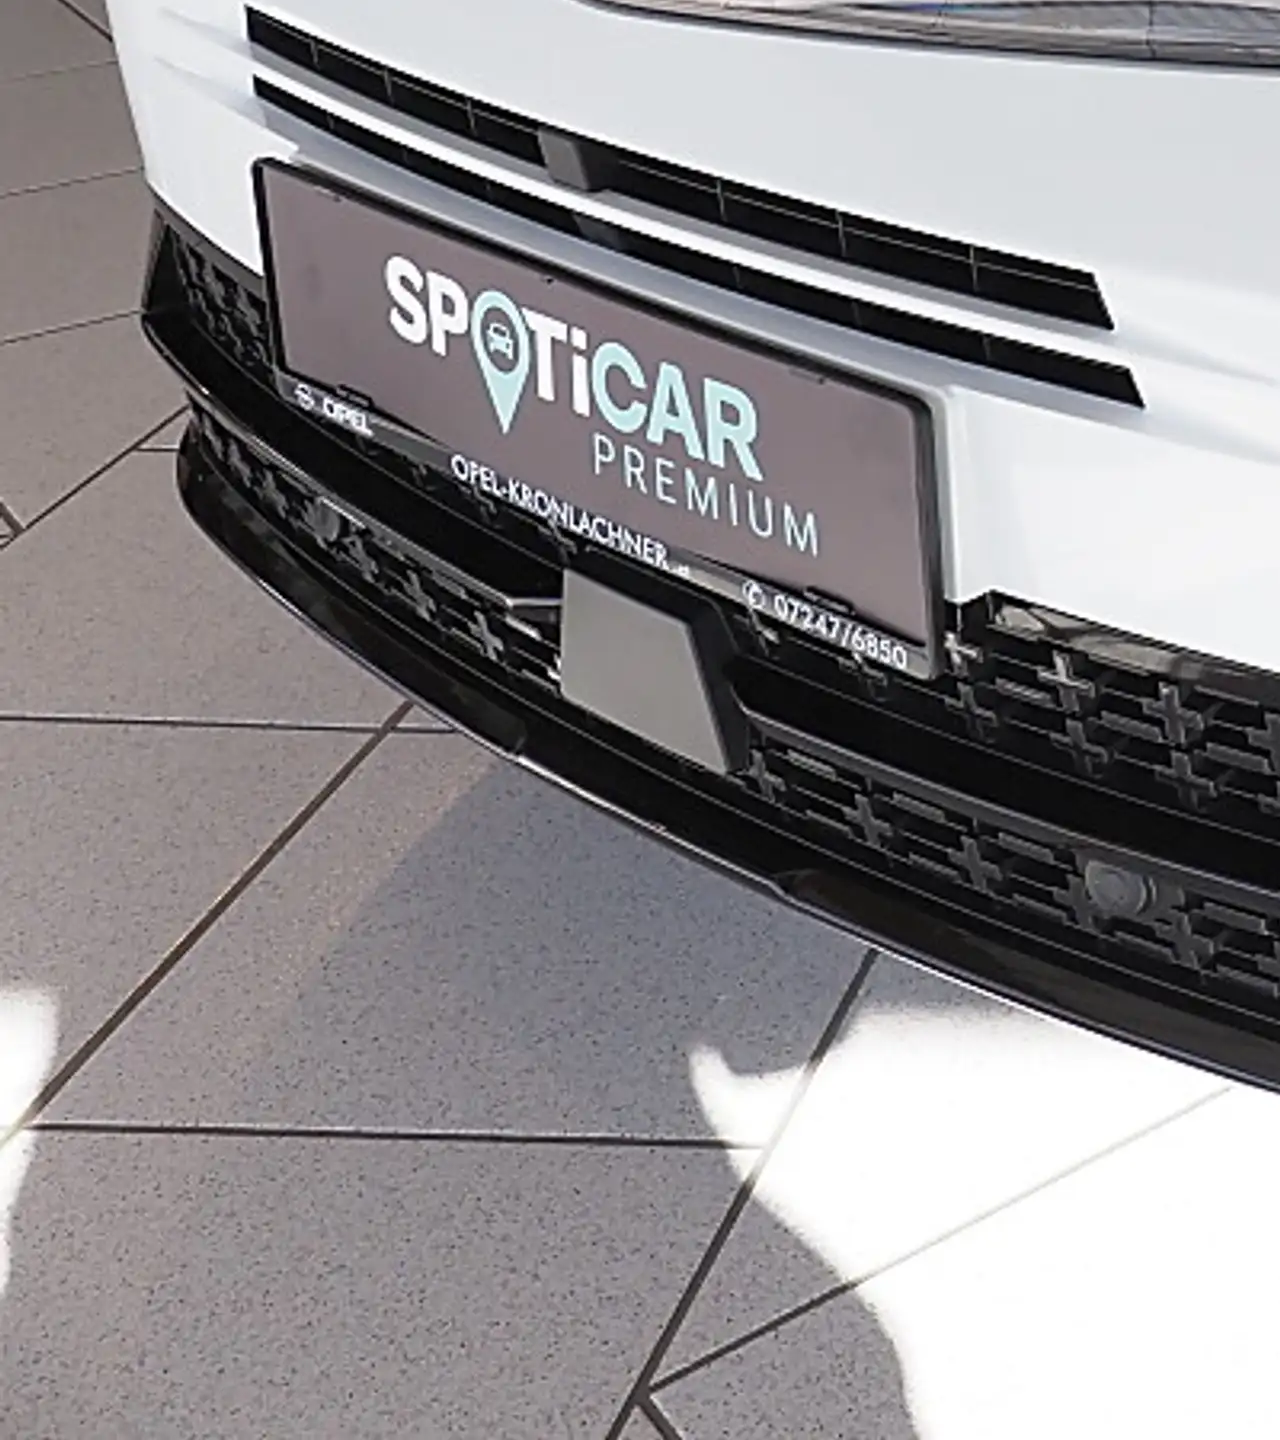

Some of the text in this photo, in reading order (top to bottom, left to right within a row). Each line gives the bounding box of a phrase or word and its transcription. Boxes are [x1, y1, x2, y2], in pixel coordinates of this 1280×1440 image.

[323, 397, 375, 438] OPEL
[592, 432, 819, 557] PREMIUM
[774, 594, 908, 670] 07247/6850
